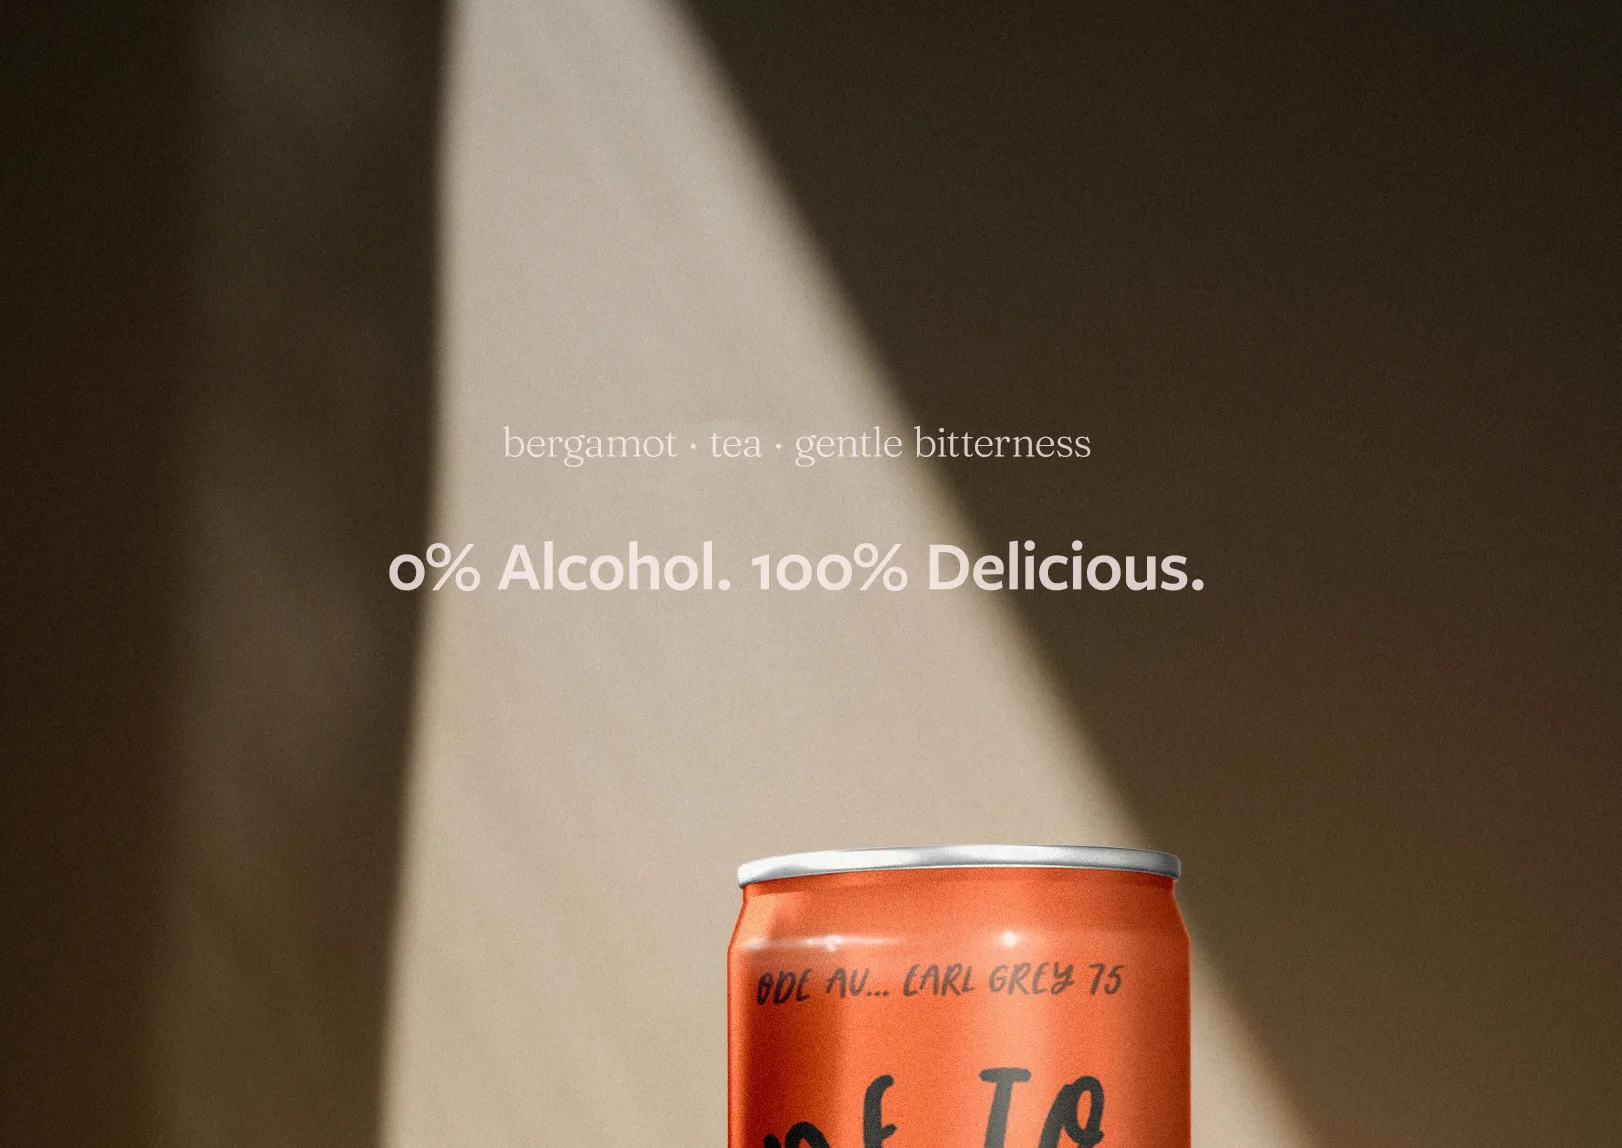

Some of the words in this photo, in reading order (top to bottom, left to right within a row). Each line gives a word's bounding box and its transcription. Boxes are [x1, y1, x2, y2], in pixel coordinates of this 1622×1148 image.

[757, 970, 812, 1005] ODE
[826, 968, 889, 998] AU...
[903, 962, 976, 997] EARL
[989, 962, 1076, 996] GREY
[1088, 962, 1126, 995] 75
